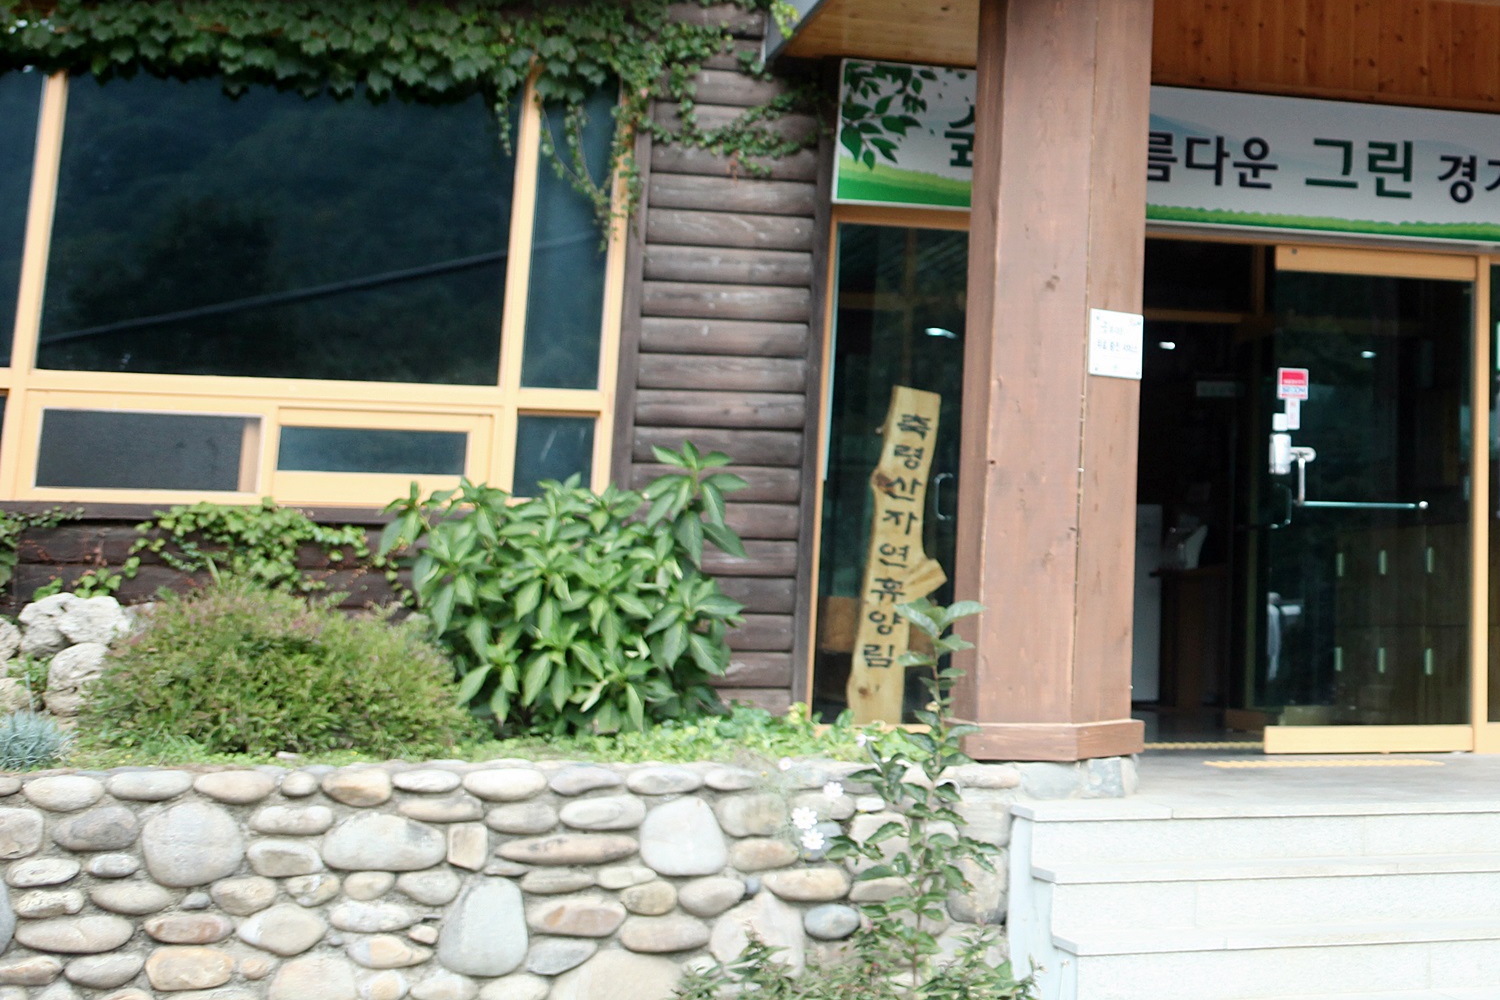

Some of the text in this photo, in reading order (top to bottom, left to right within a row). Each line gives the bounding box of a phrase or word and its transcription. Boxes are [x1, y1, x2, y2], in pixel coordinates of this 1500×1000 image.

[1147, 131, 1279, 189] 름다운
[1304, 137, 1416, 200] 그린
[863, 413, 932, 669] 축령산자연휴양림
